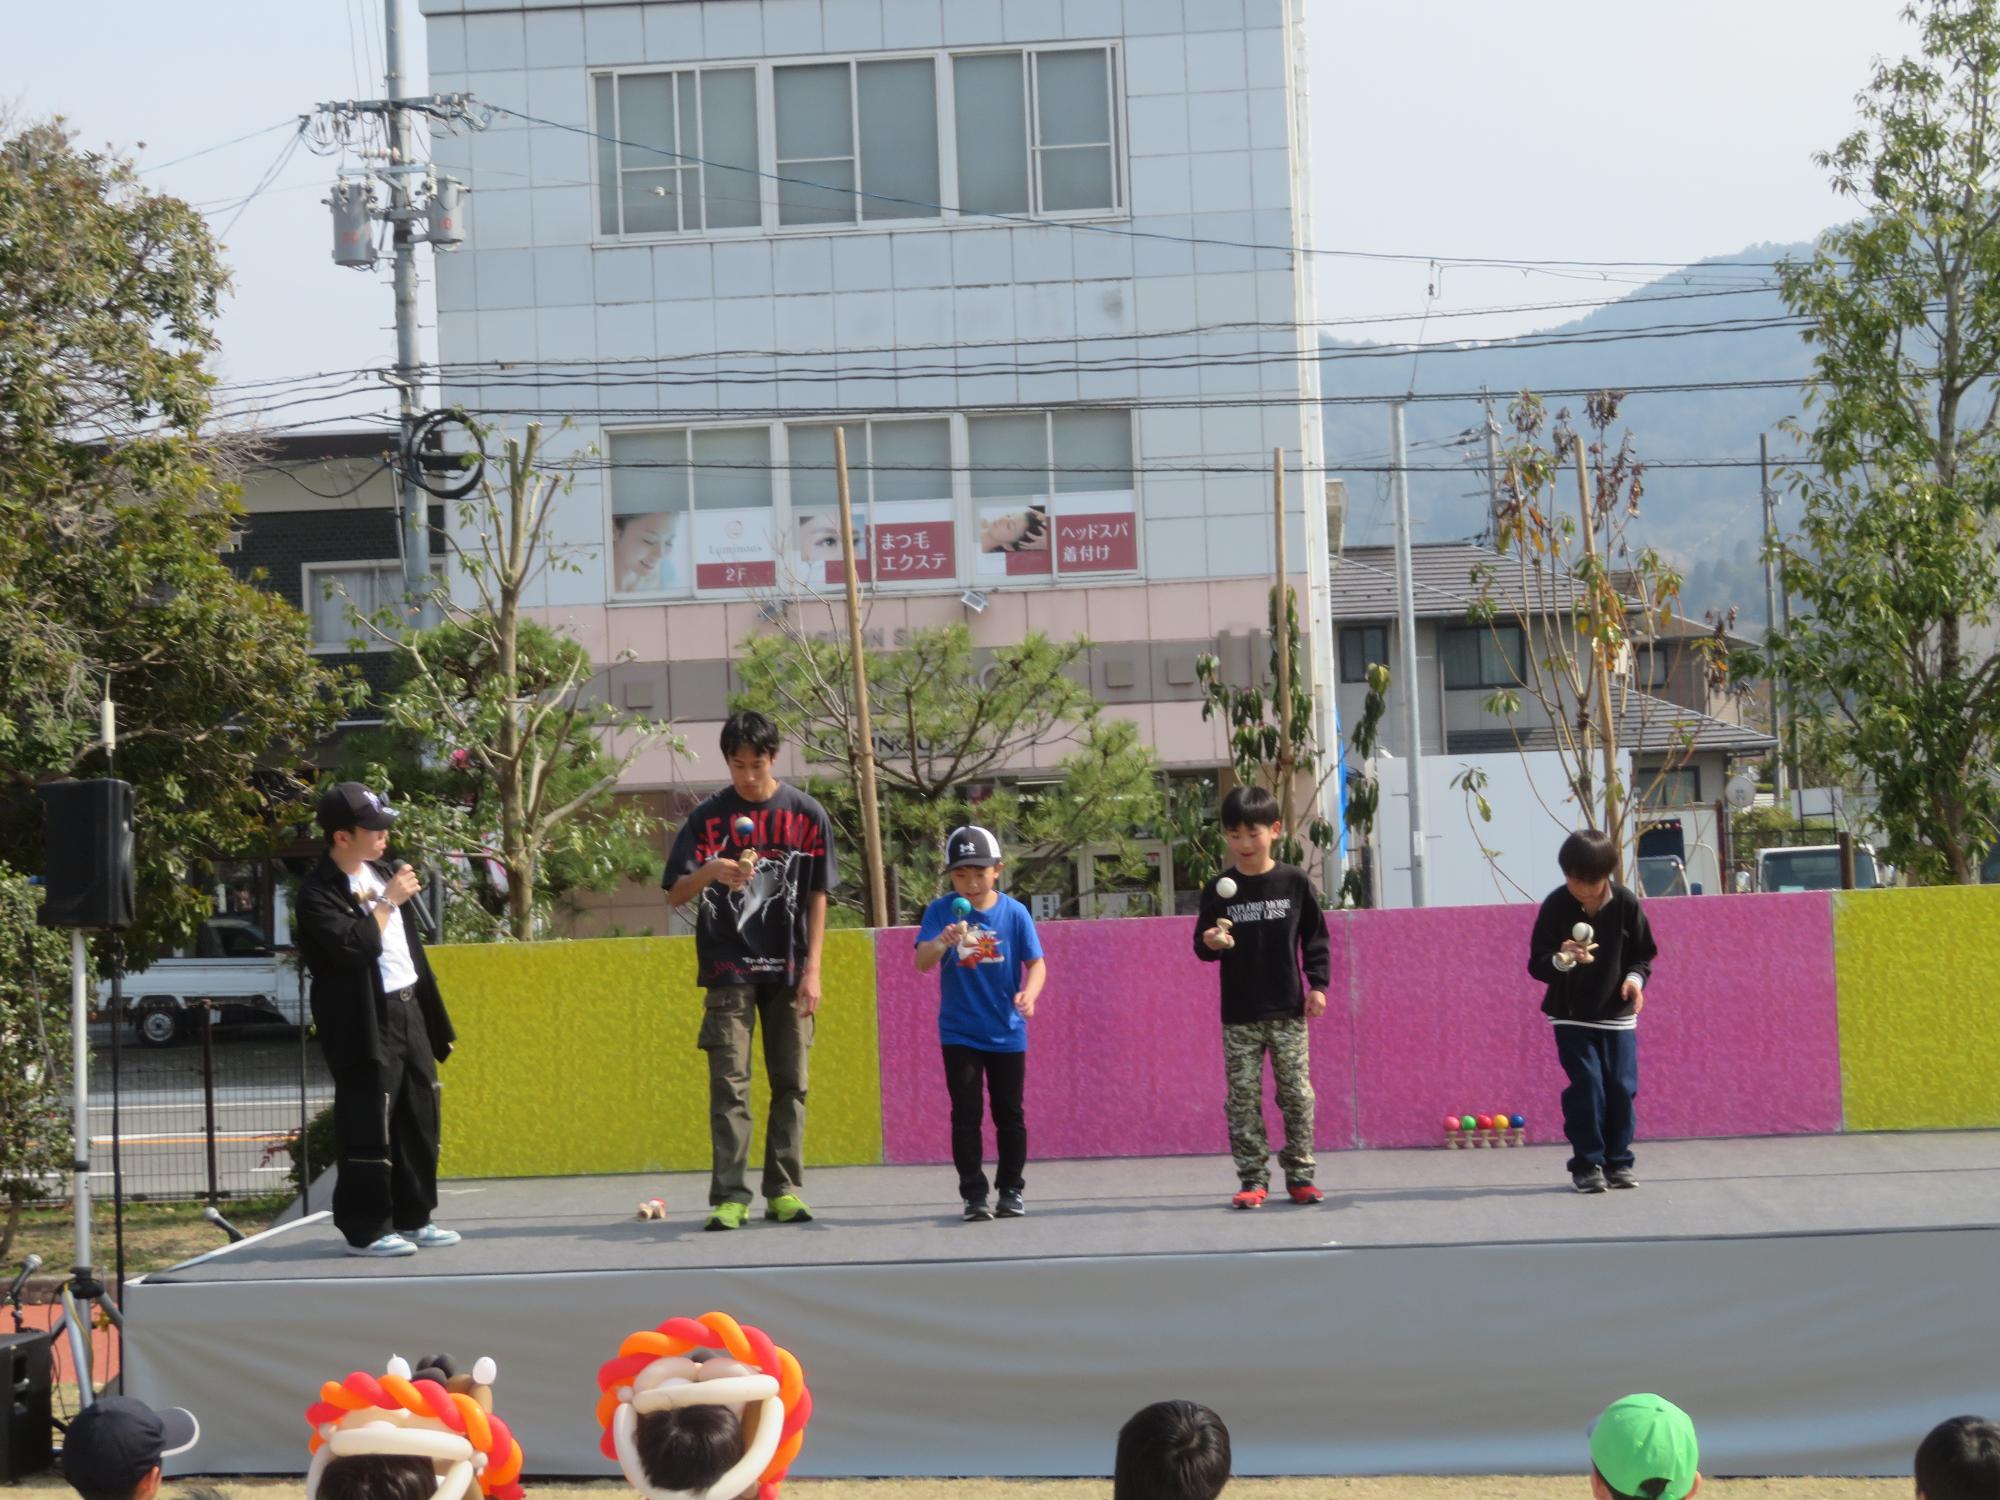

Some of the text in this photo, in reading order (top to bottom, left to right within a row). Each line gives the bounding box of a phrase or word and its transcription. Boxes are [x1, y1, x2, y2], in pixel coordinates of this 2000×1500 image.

[1061, 521, 1128, 540] ヘッドスパ
[881, 531, 930, 551] まつ毛
[881, 553, 947, 571] エクステ
[1064, 544, 1111, 562] 着付け
[725, 567, 747, 581] 2F
[1226, 899, 1290, 916] EXPLORE MORE
[1231, 909, 1286, 922] WORRY LESS
